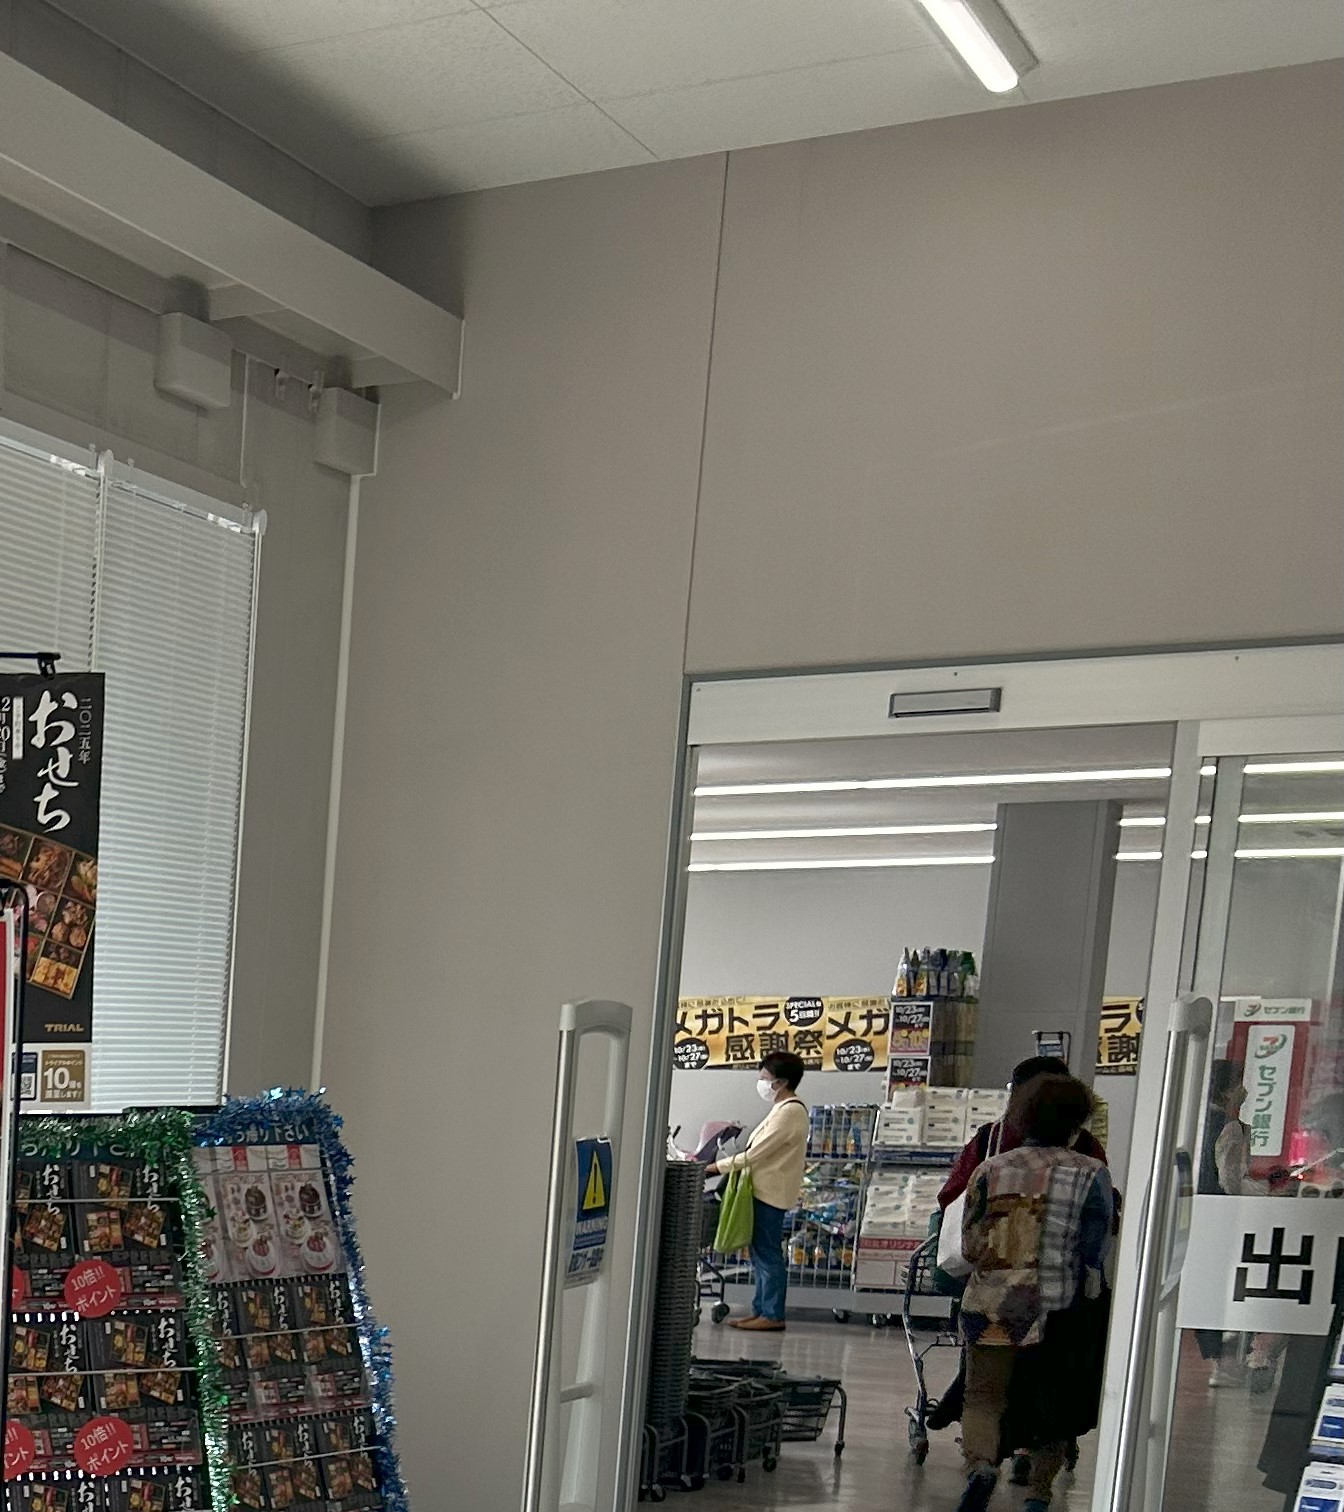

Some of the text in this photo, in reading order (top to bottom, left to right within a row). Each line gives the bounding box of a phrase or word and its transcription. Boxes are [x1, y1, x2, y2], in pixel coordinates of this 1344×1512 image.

[28, 690, 79, 833] おせち
[44, 1023, 84, 1032] TRIAL
[826, 1008, 890, 1040] メガ
[1101, 1003, 1132, 1032] ラ
[72, 1266, 105, 1291] 10倍!!
[75, 1286, 117, 1313] ポイント
[81, 1422, 116, 1450] 10倍!!
[87, 1441, 129, 1471] ポイント
